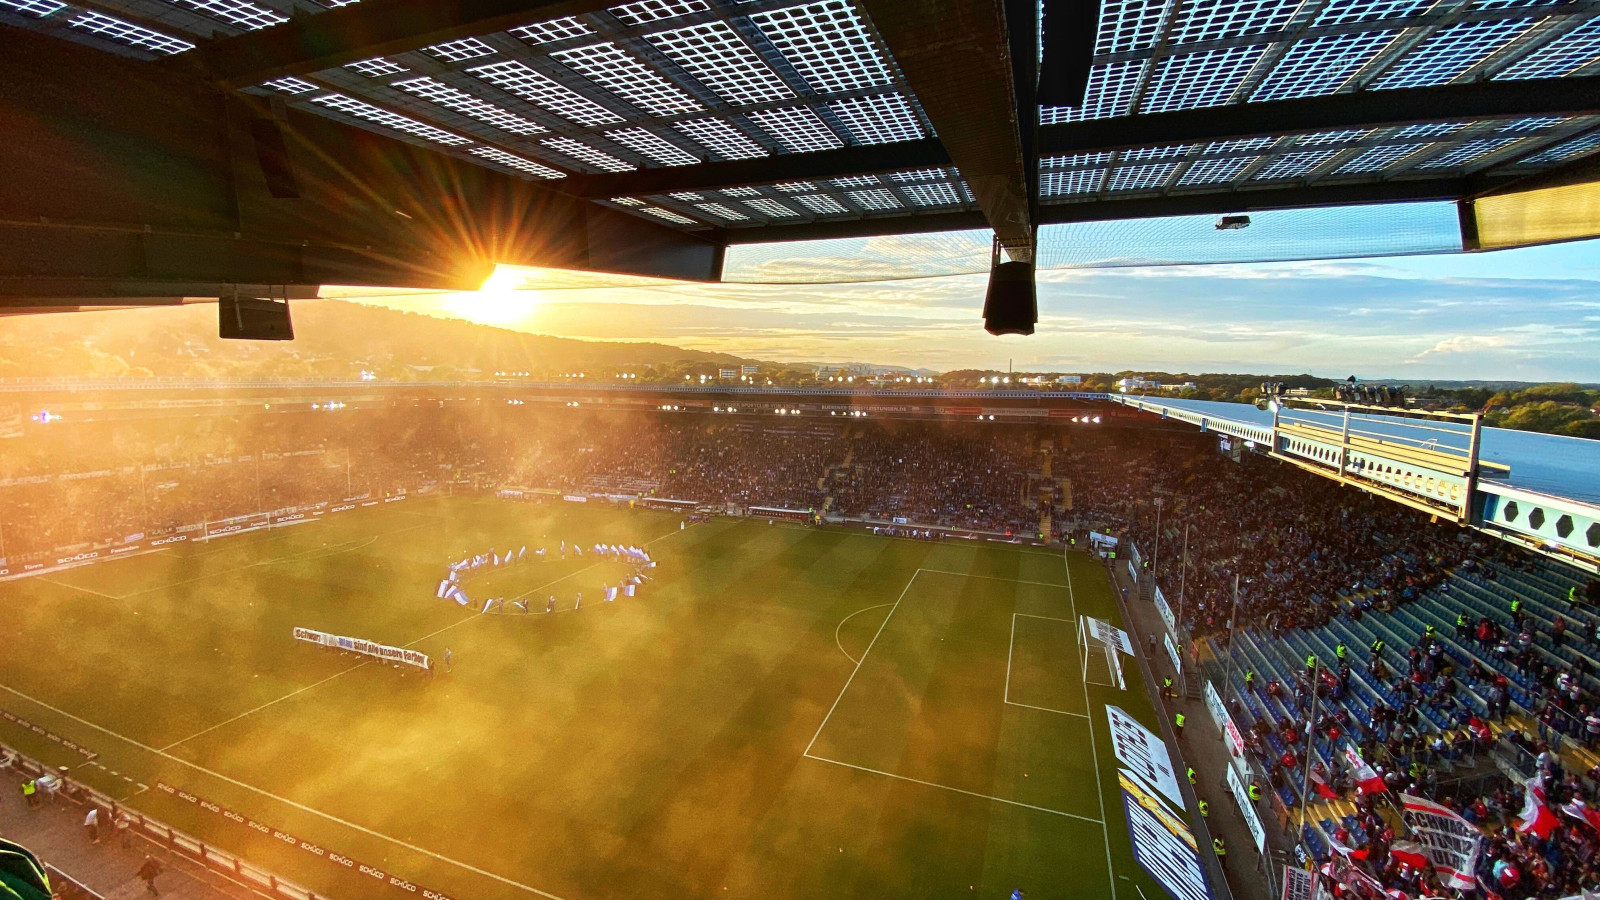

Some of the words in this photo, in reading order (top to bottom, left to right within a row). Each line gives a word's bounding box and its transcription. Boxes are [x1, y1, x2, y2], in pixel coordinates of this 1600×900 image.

[151, 535, 187, 546] SCHÜCO
[57, 552, 98, 564] SCHÜCO
[353, 640, 368, 652] sind
[368, 644, 379, 655] alle
[379, 646, 403, 660] unsere
[403, 650, 426, 665] Farben
[223, 811, 244, 823] SCHÜCO
[248, 821, 270, 833] SCHÜCO
[273, 831, 296, 844] SCHÜCO
[300, 842, 324, 856] SCHÜCO
[329, 852, 354, 867] SCHÜCO
[359, 864, 385, 880] SCHÜCO
[389, 877, 417, 892] SCHÜCO
